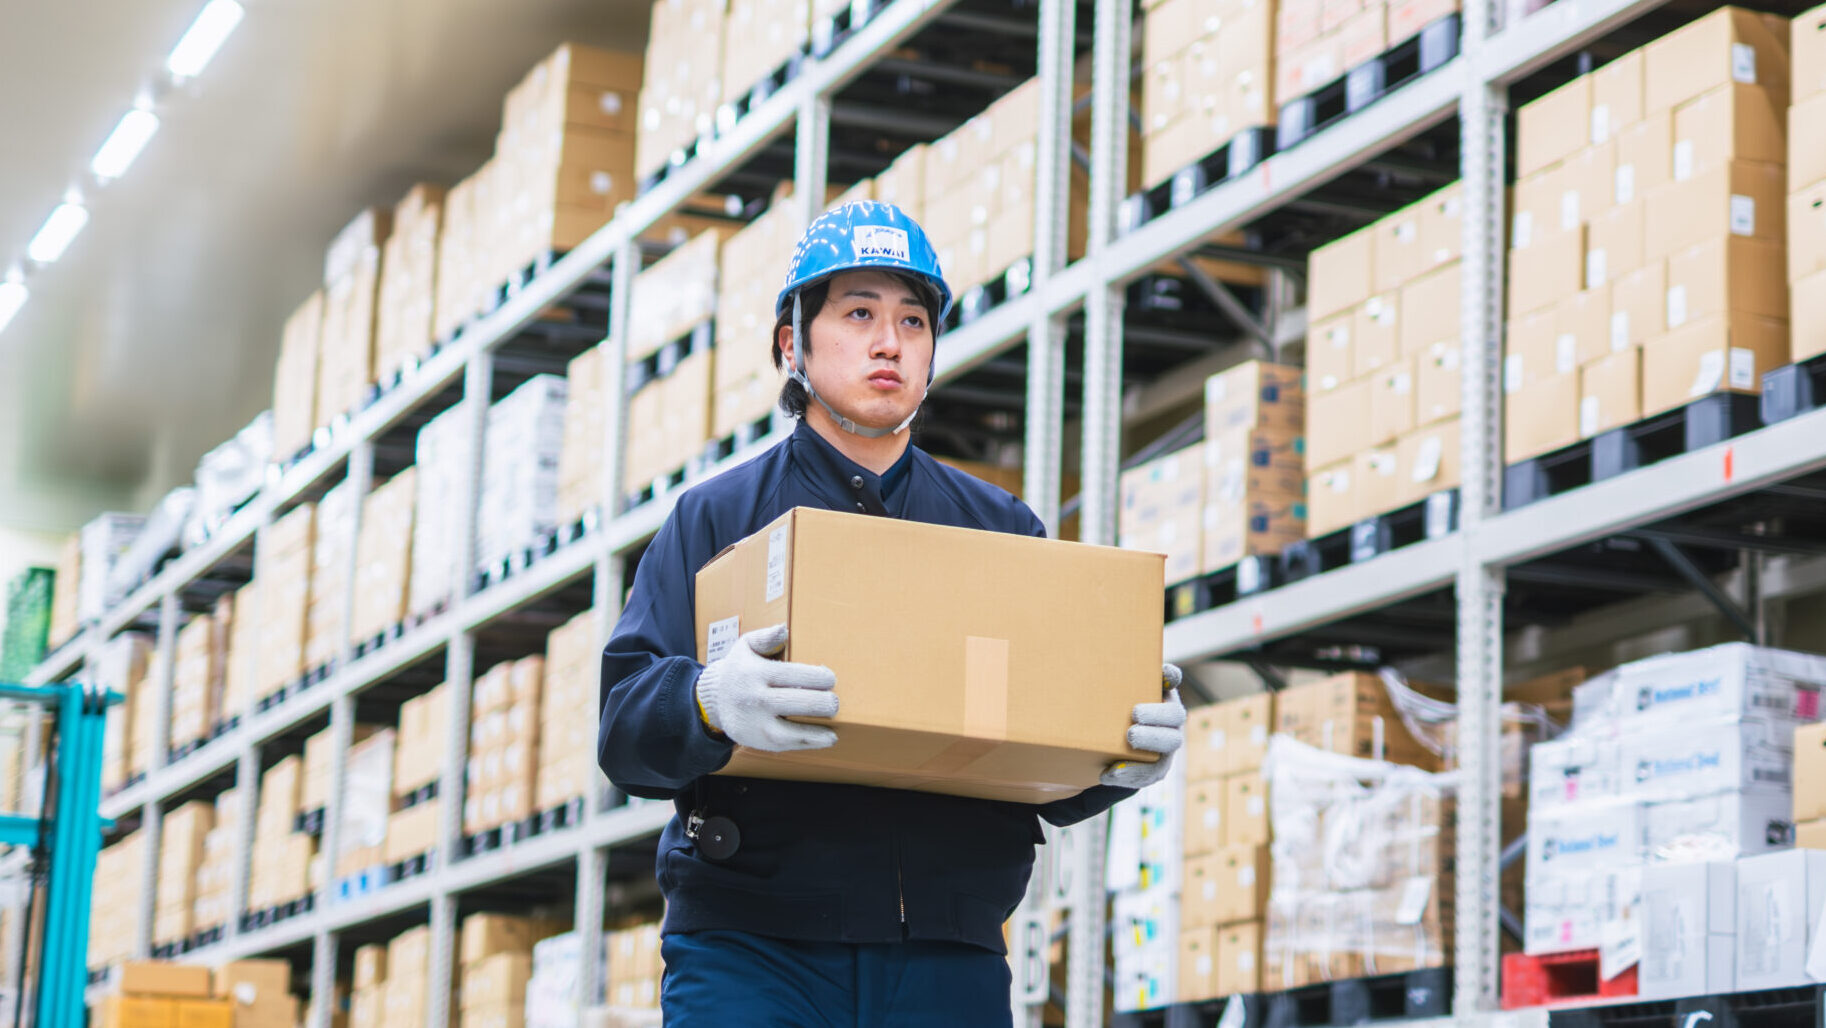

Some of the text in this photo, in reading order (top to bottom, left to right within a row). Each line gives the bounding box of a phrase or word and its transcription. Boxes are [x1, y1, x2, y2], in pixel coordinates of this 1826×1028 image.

[861, 246, 905, 258] KAWAI
[1054, 828, 1074, 897] C
[1022, 921, 1045, 994] B
